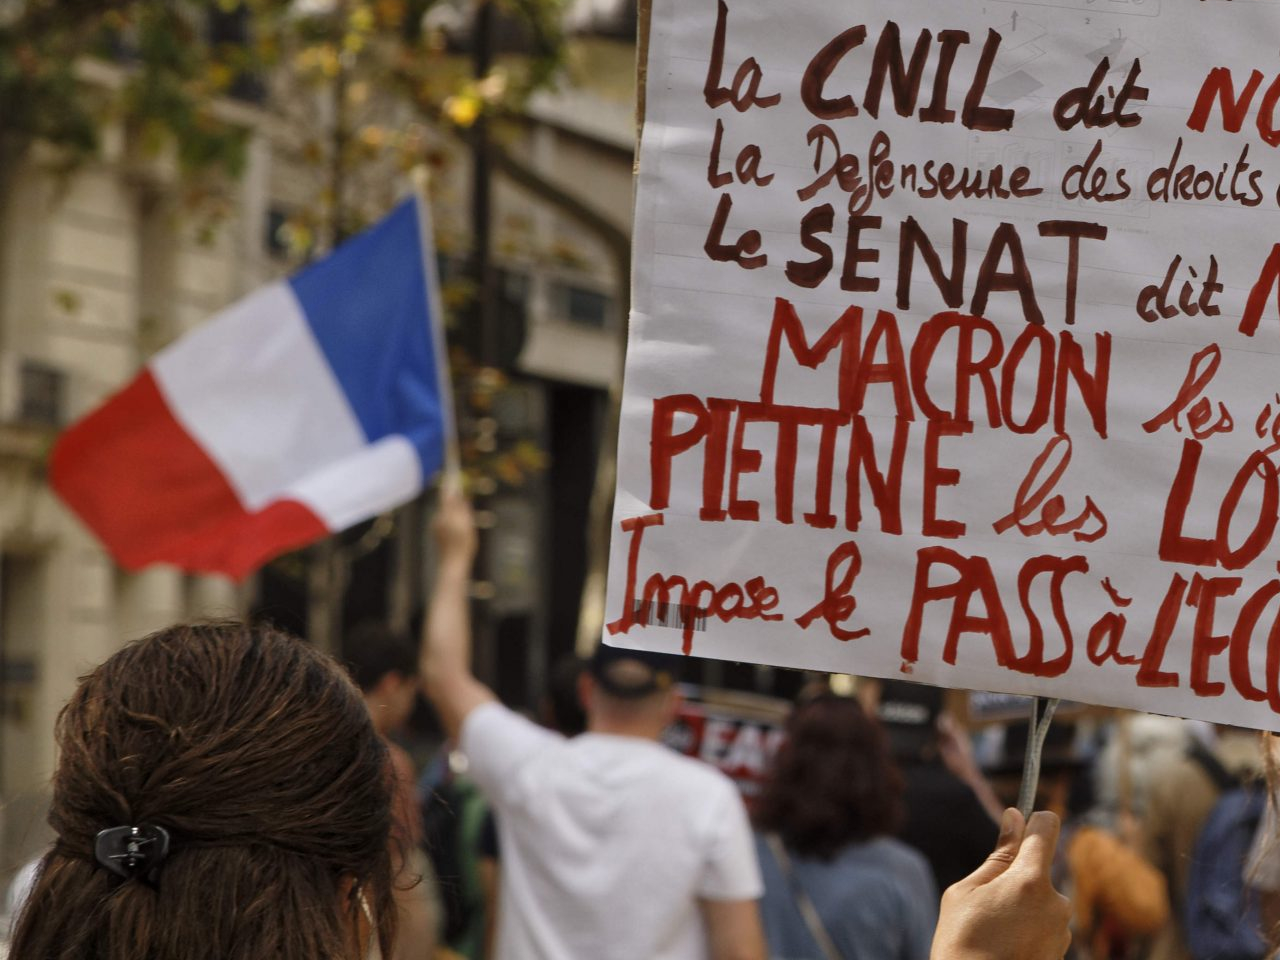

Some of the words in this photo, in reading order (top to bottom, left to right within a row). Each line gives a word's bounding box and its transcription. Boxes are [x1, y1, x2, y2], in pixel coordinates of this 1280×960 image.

[703, 0, 781, 112] La
[800, 20, 1015, 131] CNIL
[1053, 56, 1149, 130] dit
[708, 119, 775, 188] La
[1062, 139, 1131, 201] des
[1147, 137, 1263, 206] droits
[704, 193, 767, 269] Le
[785, 203, 1107, 325] SENAT
[1136, 255, 1223, 322] dit
[760, 297, 1111, 438] MACRON
[1142, 343, 1233, 439] les
[650, 394, 973, 538] PIETINE
[992, 434, 1107, 542] les
[606, 513, 783, 656] Impose
[795, 540, 870, 641] le
[900, 545, 1089, 678] PASS
[1087, 577, 1141, 666] à
